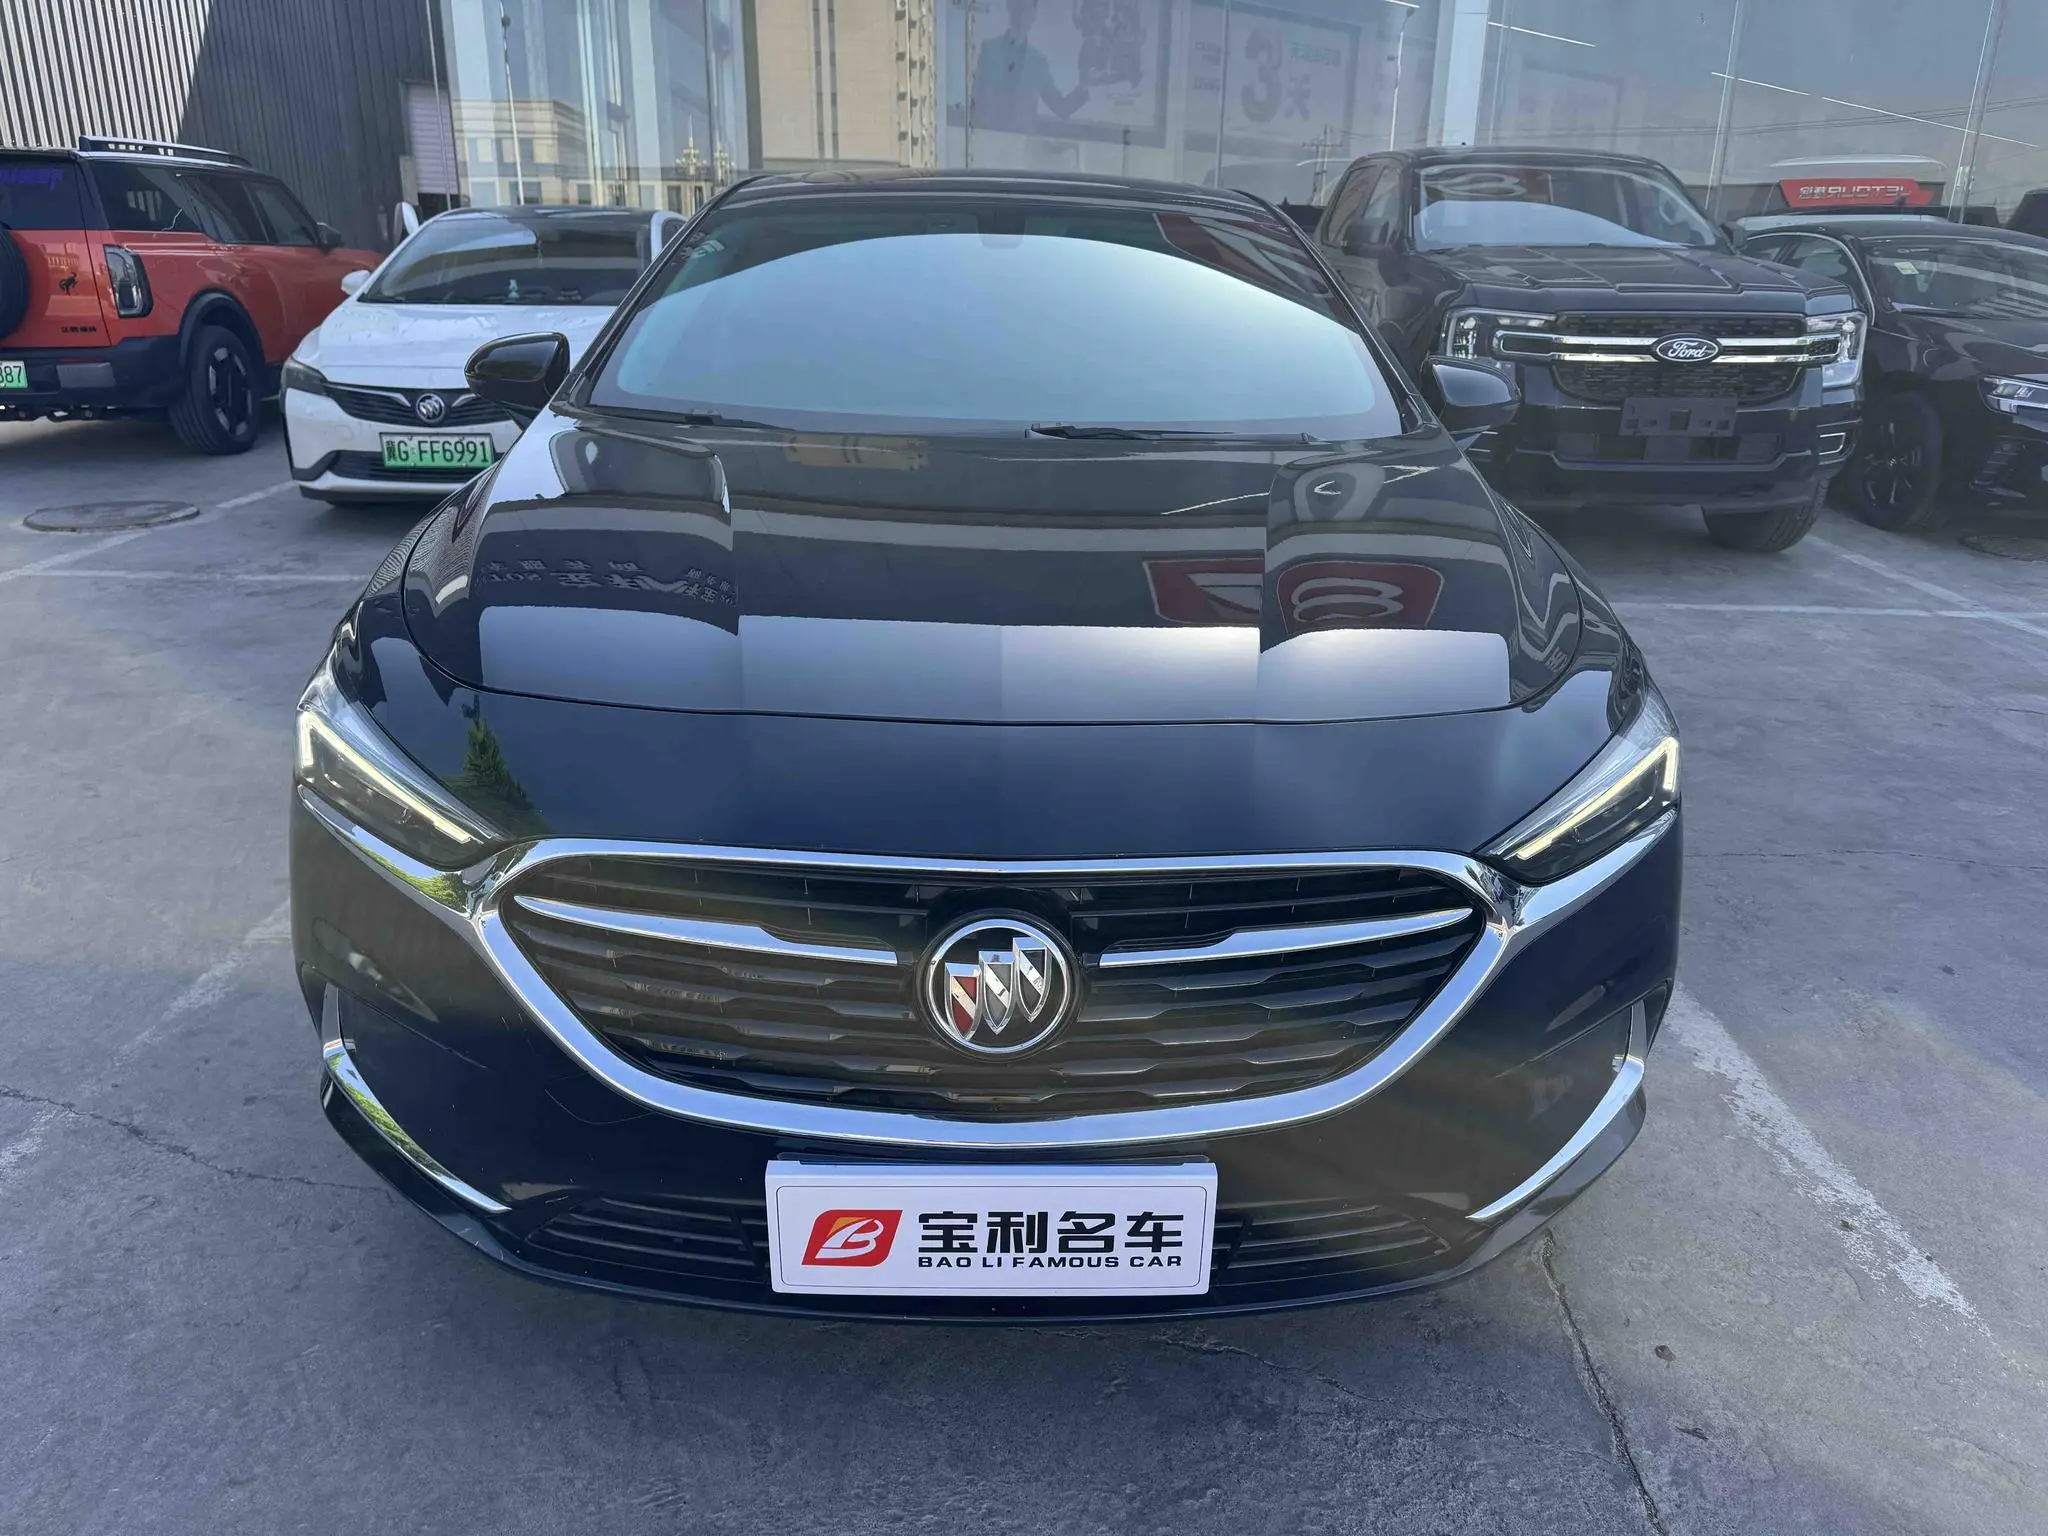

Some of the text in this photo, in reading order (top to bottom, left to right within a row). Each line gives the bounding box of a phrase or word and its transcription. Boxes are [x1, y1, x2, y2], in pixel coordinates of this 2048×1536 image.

[1668, 341, 1707, 358] Ford
[918, 1211, 1183, 1253] 宝利名车
[918, 1256, 1182, 1268] BAO LI FAMOUS CAR
